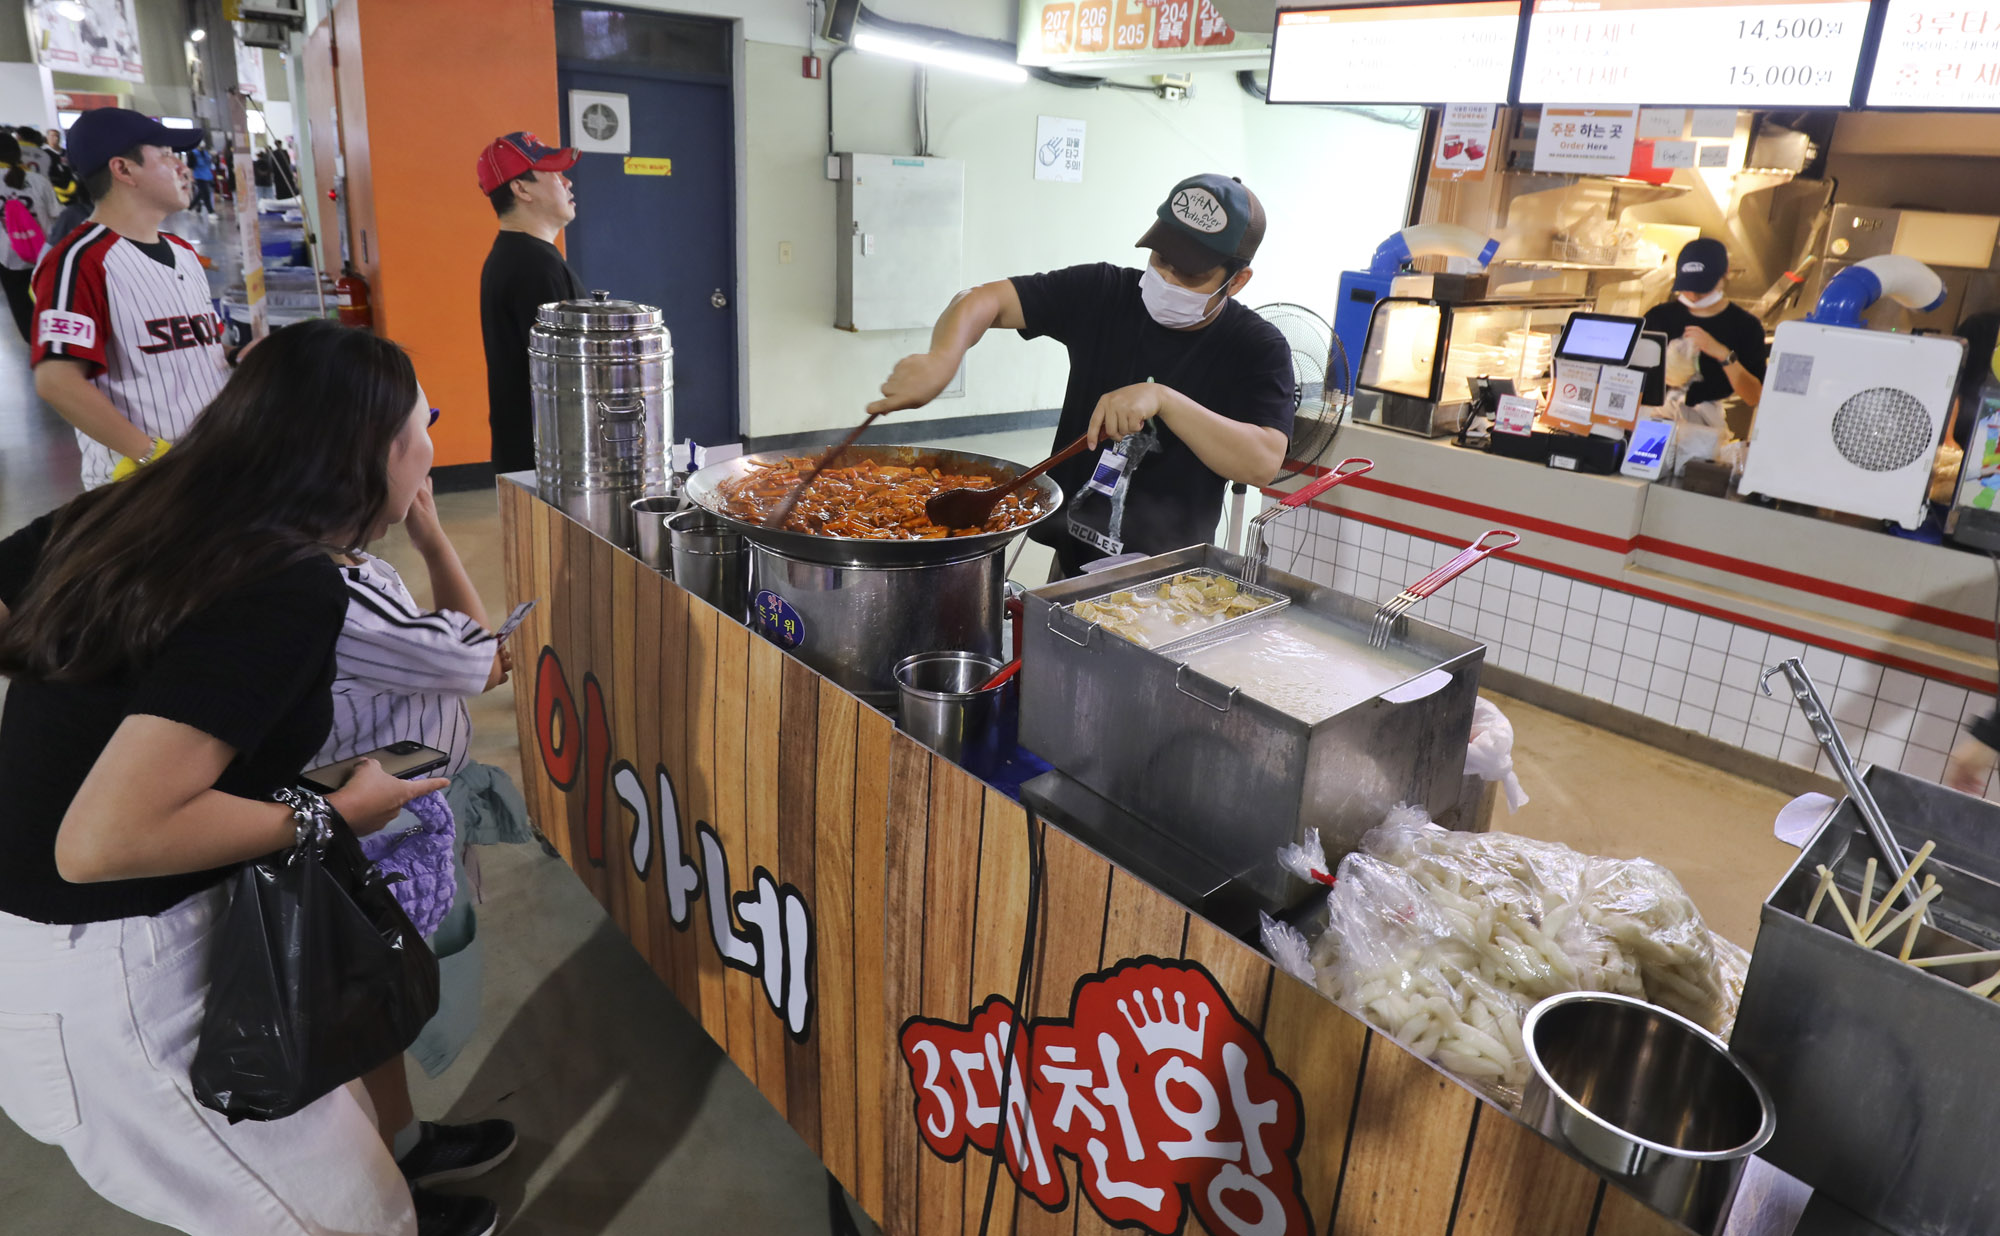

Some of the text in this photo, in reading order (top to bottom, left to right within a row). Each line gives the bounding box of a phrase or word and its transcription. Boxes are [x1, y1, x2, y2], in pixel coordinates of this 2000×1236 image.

[1045, 10, 1070, 30] 207
[1081, 7, 1107, 28] 206
[1160, 3, 1188, 24] 204
[1906, 10, 2000, 35] 3루타
[1118, 24, 1145, 45] 205
[1551, 122, 1623, 140] 주문 하는 곳
[1066, 136, 1081, 149] 파울
[1560, 141, 1609, 151] Order Here
[1065, 148, 1080, 160] 타구
[1064, 159, 1081, 171] 주의!
[1177, 206, 1213, 231] Adhere
[534, 645, 813, 1044] 이가네
[912, 1020, 1287, 1236] 3대천왕
